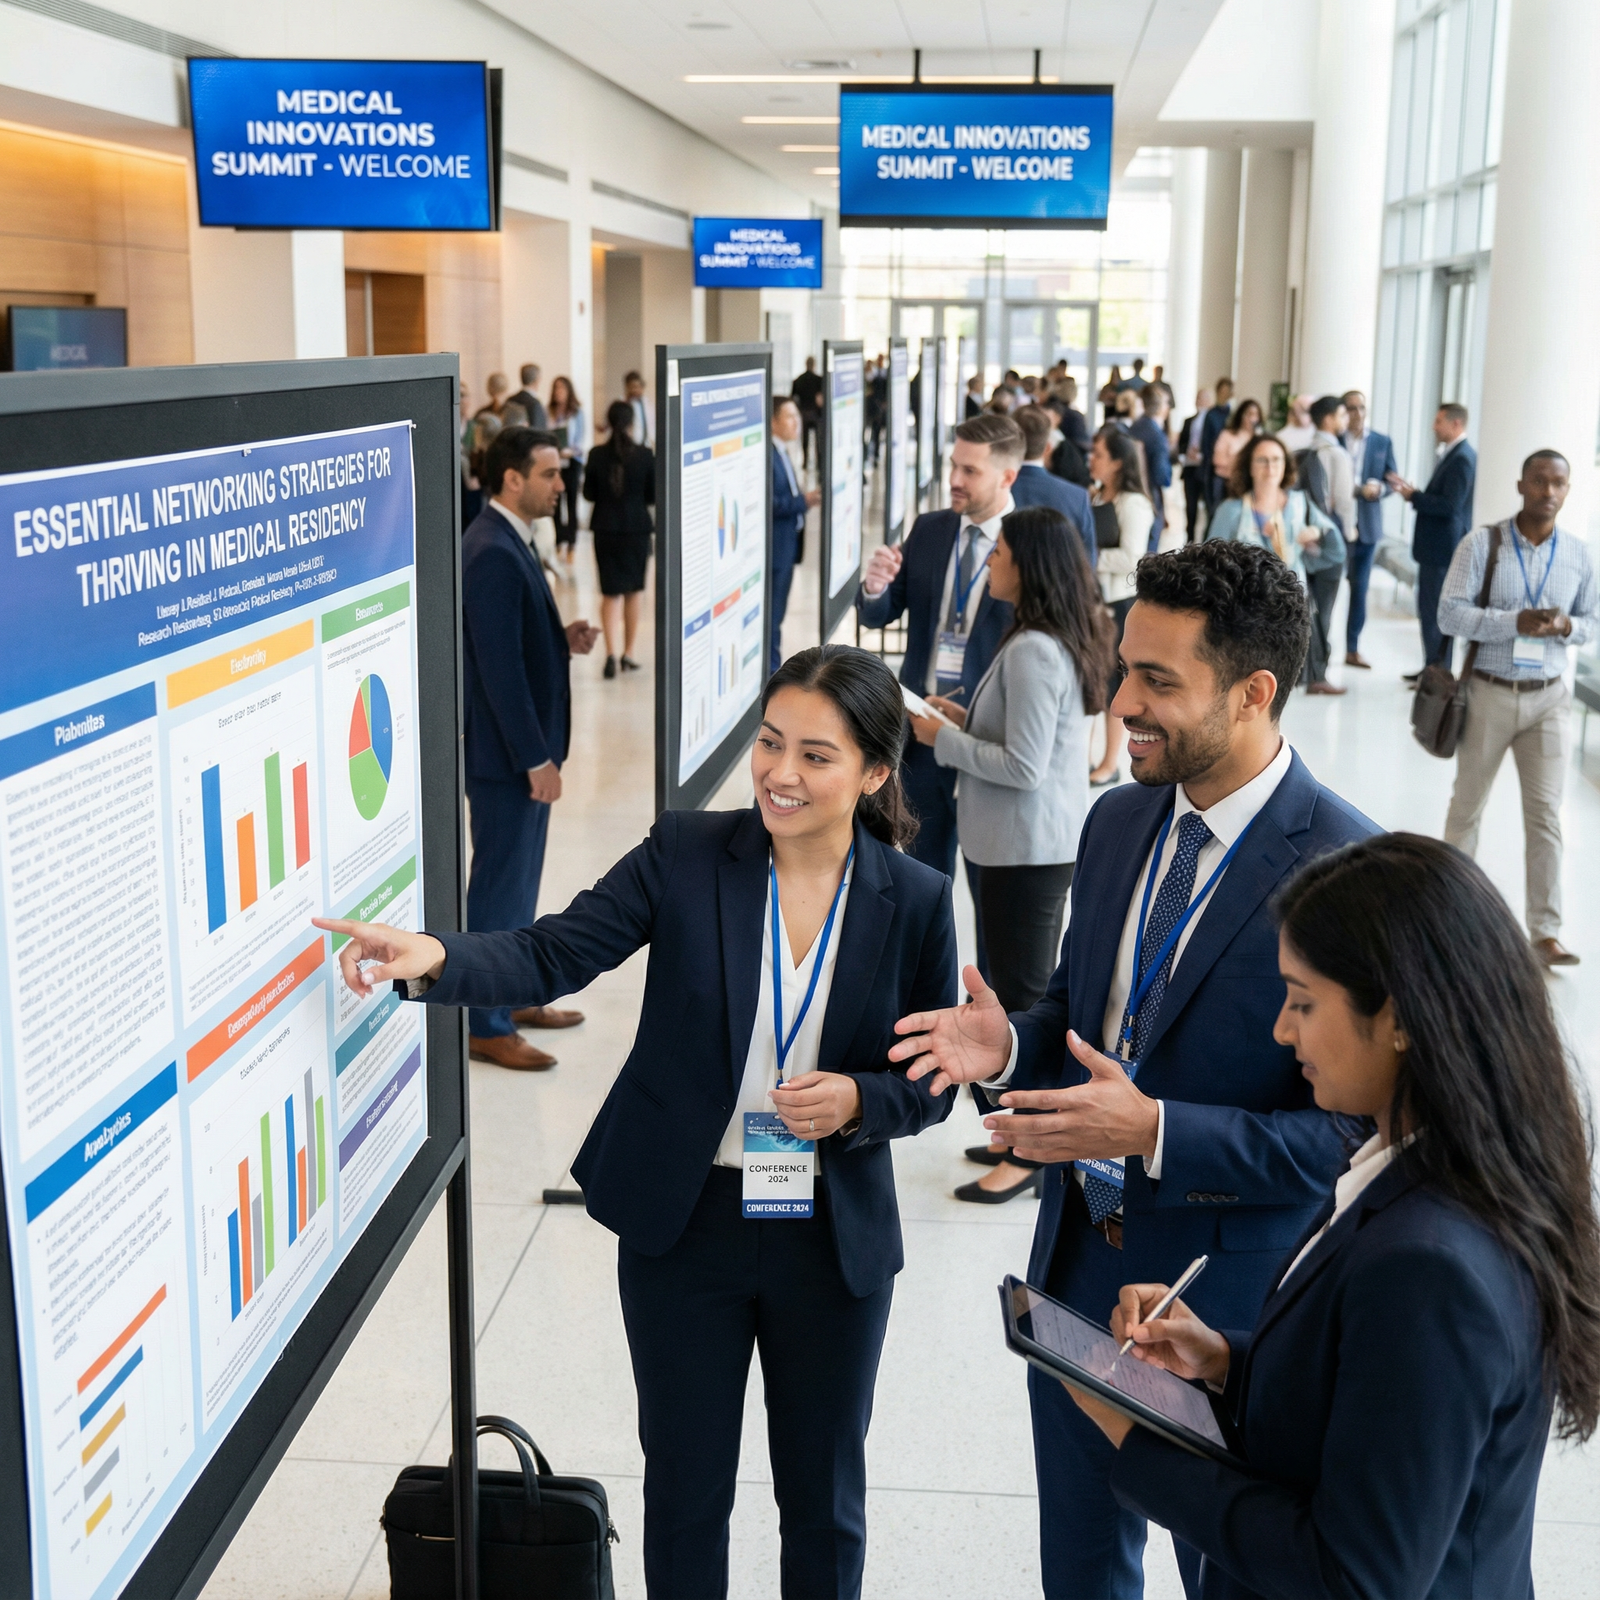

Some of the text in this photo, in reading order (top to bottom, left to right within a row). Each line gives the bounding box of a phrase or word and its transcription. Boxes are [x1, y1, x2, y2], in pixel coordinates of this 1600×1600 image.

[277, 89, 402, 115] MEDICAL
[247, 120, 435, 147] INNOVATIONS
[862, 125, 1091, 150] MEDICAL INNOVATIONS
[212, 152, 317, 177] SUMMIT
[339, 154, 471, 179] WELCOME
[877, 155, 957, 180] SUMMIT
[971, 156, 1074, 181] WELCOME
[14, 447, 391, 558] ESSENTIAL NETWORKING STRATEGIES FOR
[76, 542, 182, 607] THRIVING
[186, 536, 206, 578] IN
[210, 519, 286, 571] MEDICAL
[288, 496, 367, 549] RESIDENCY
[749, 1165, 808, 1173] CONFERENCE
[768, 1175, 789, 1183] 2024
